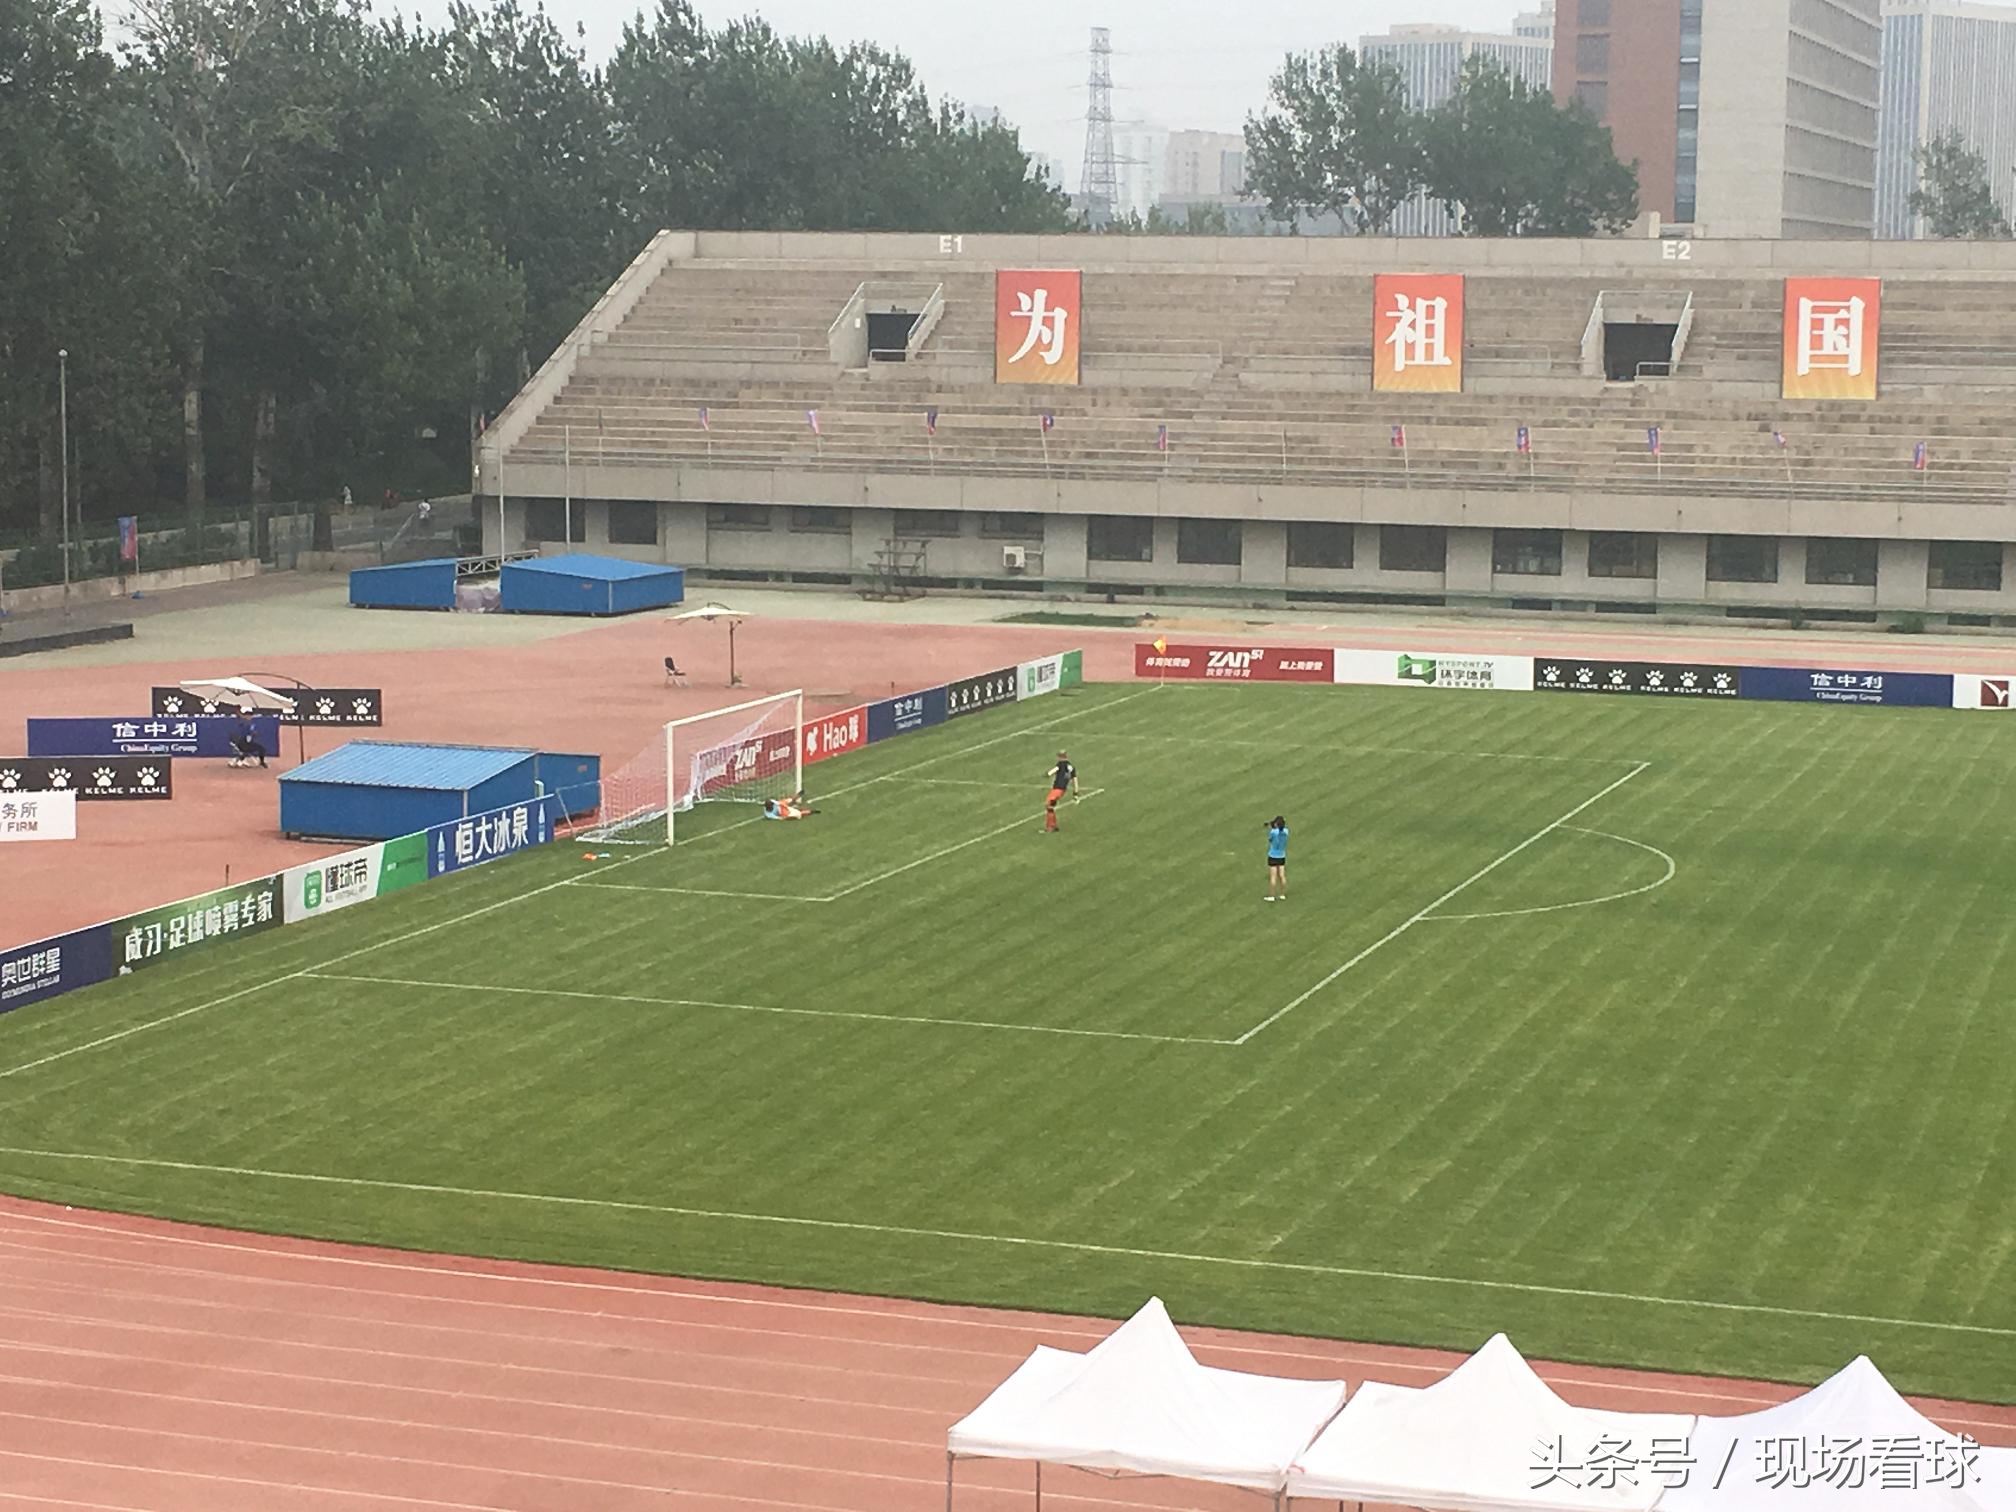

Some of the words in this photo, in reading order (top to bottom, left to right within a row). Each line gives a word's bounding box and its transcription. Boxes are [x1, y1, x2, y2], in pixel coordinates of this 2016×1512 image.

[939, 235, 963, 253] E1
[1662, 240, 1691, 260] E2
[1008, 288, 1068, 365] 为
[1385, 293, 1453, 372] 祖
[1797, 296, 1865, 376] 国
[1810, 673, 1883, 689] 信中利
[112, 721, 197, 738] 信中利
[85, 786, 124, 795] KELME
[129, 785, 167, 794] KELME
[7, 821, 38, 832] FIRM
[455, 806, 529, 865] 恒大冰泉
